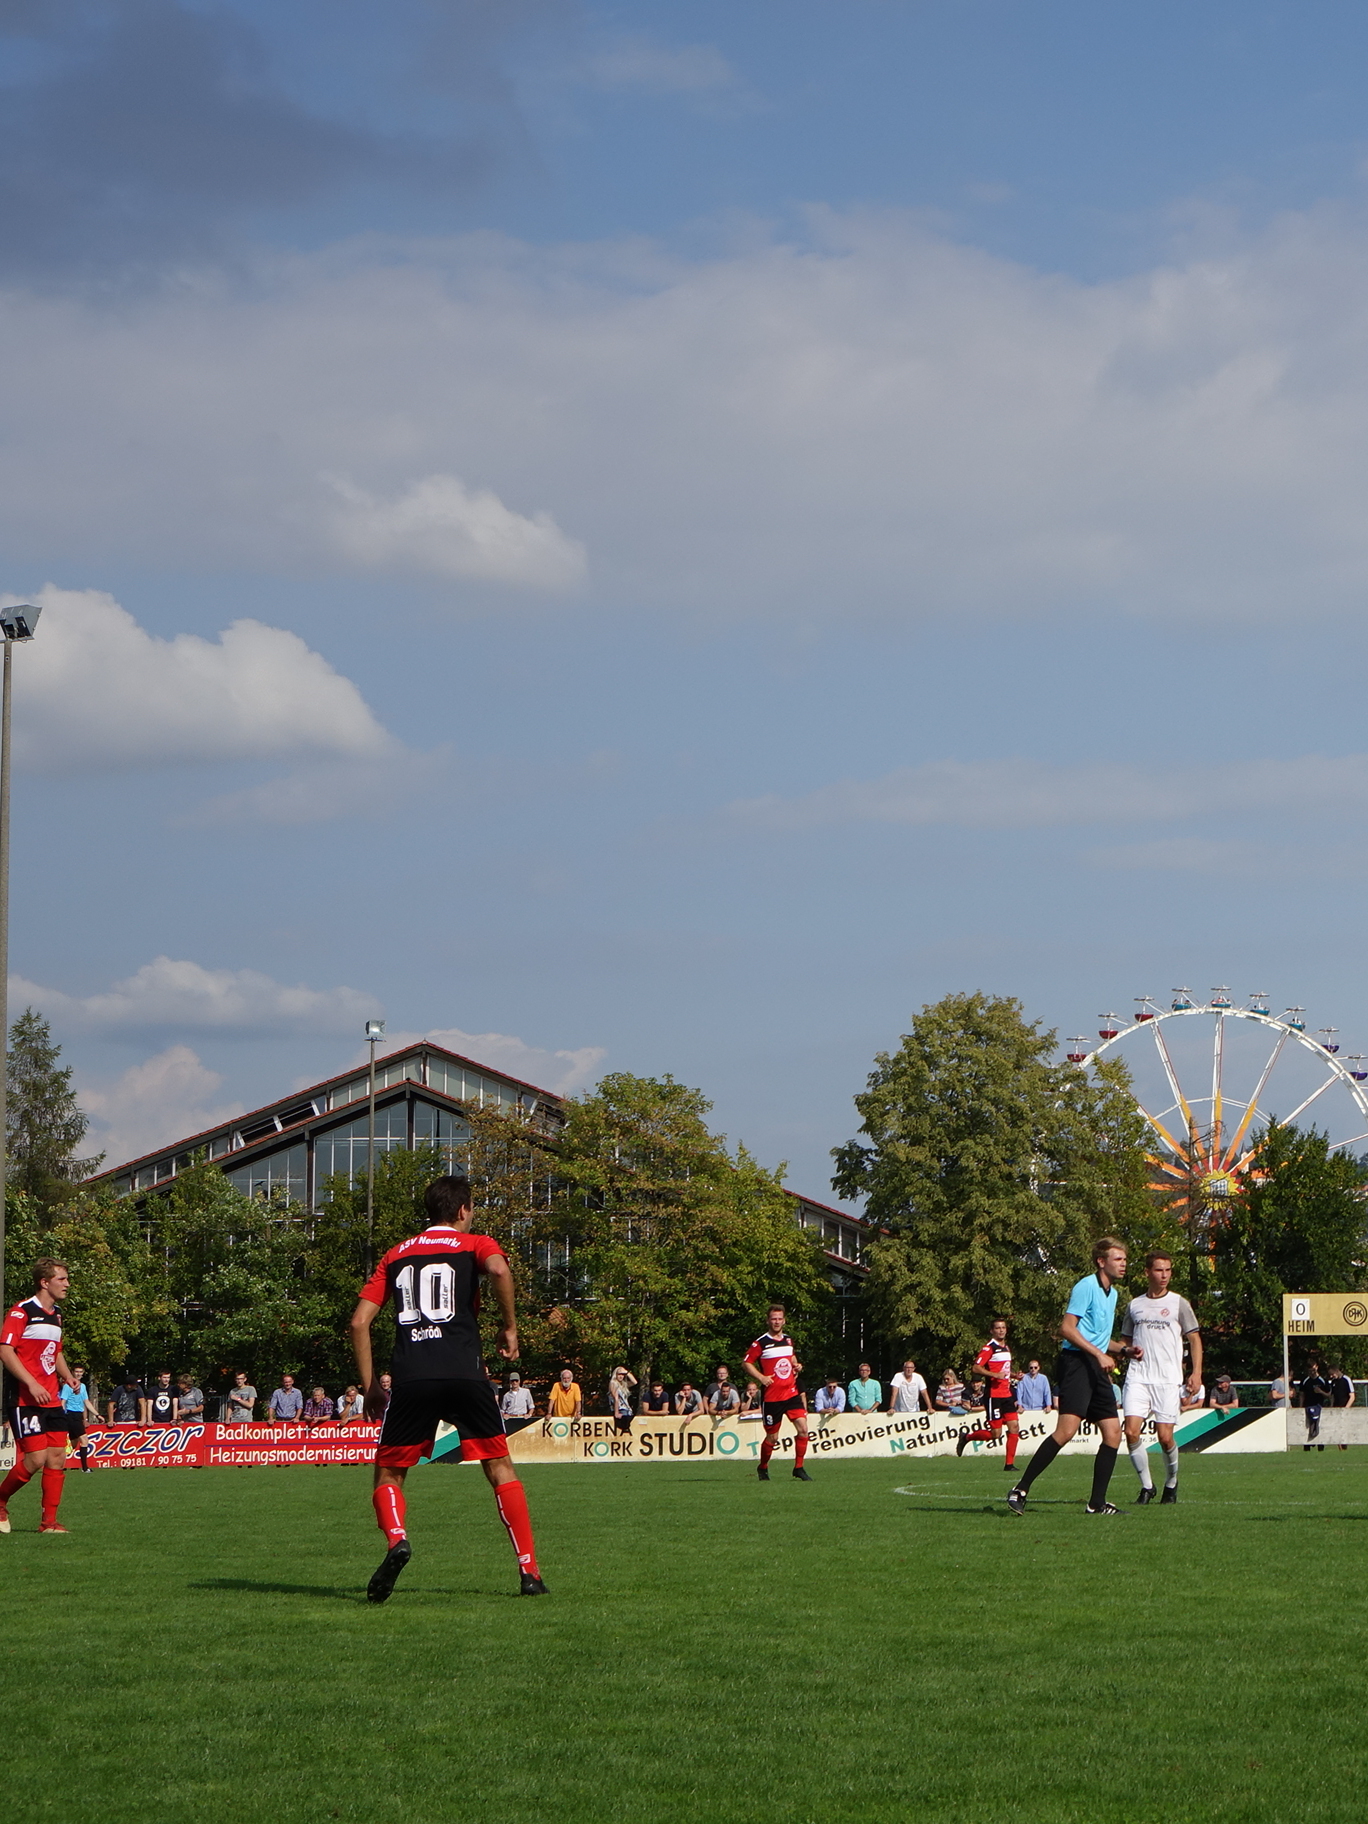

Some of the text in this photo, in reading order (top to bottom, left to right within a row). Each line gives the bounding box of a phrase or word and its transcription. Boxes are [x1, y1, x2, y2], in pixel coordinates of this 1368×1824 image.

[398, 1237, 418, 1253] ASV
[395, 1262, 456, 1325] 10
[1296, 1303, 1306, 1316] 0
[1147, 1323, 1167, 1331] druck
[1288, 1320, 1315, 1333] HEIM
[994, 1408, 1002, 1419] 5
[22, 1415, 42, 1435] 14
[812, 1415, 930, 1453] renovierung
[583, 1431, 740, 1457] KORK STUDIO
[889, 1418, 991, 1453] Naturböde
[972, 1421, 1047, 1453] Parett
[121, 1458, 146, 1468] 09181
[158, 1456, 169, 1465] 90
[172, 1455, 183, 1464] 75
[186, 1454, 197, 1463] 75
